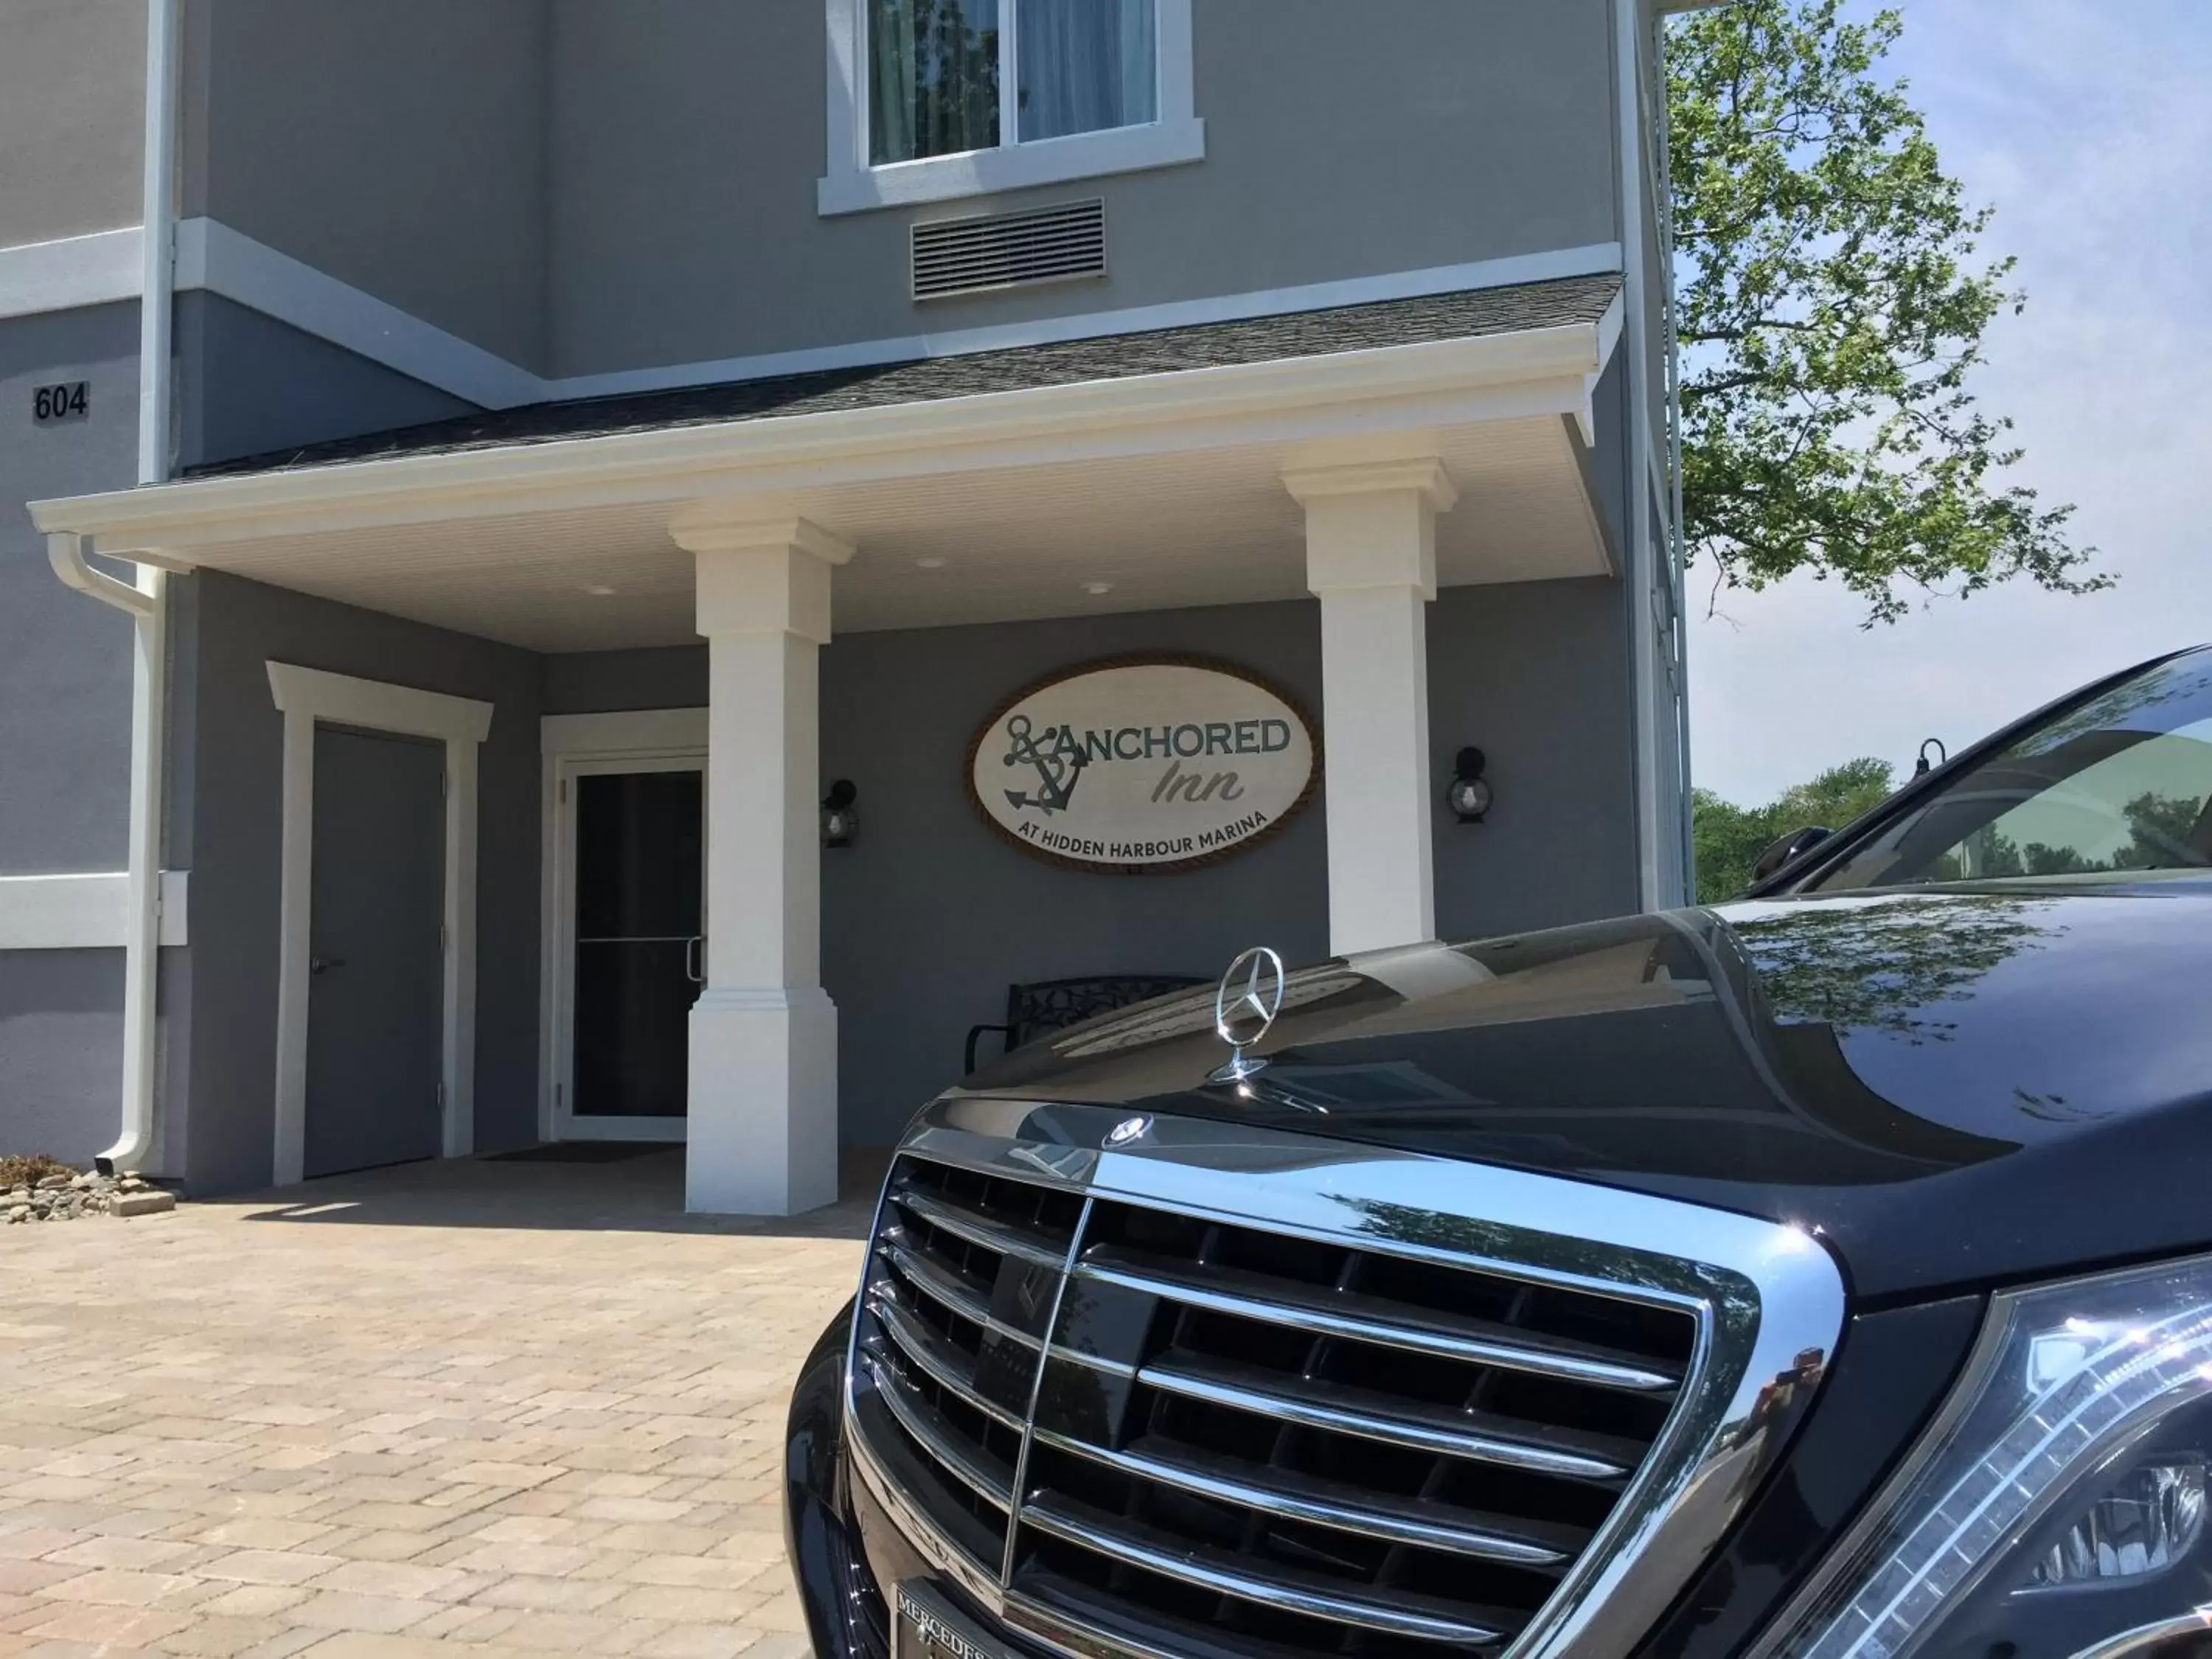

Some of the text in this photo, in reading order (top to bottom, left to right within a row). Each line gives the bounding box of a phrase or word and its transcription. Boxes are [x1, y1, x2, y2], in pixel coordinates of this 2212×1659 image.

[35, 383, 87, 420] 604
[1053, 719, 1291, 762] ANCHORED
[1151, 760, 1244, 804] Inn
[1018, 810, 1267, 858] AT HIDDEN HARBOUR MARINA
